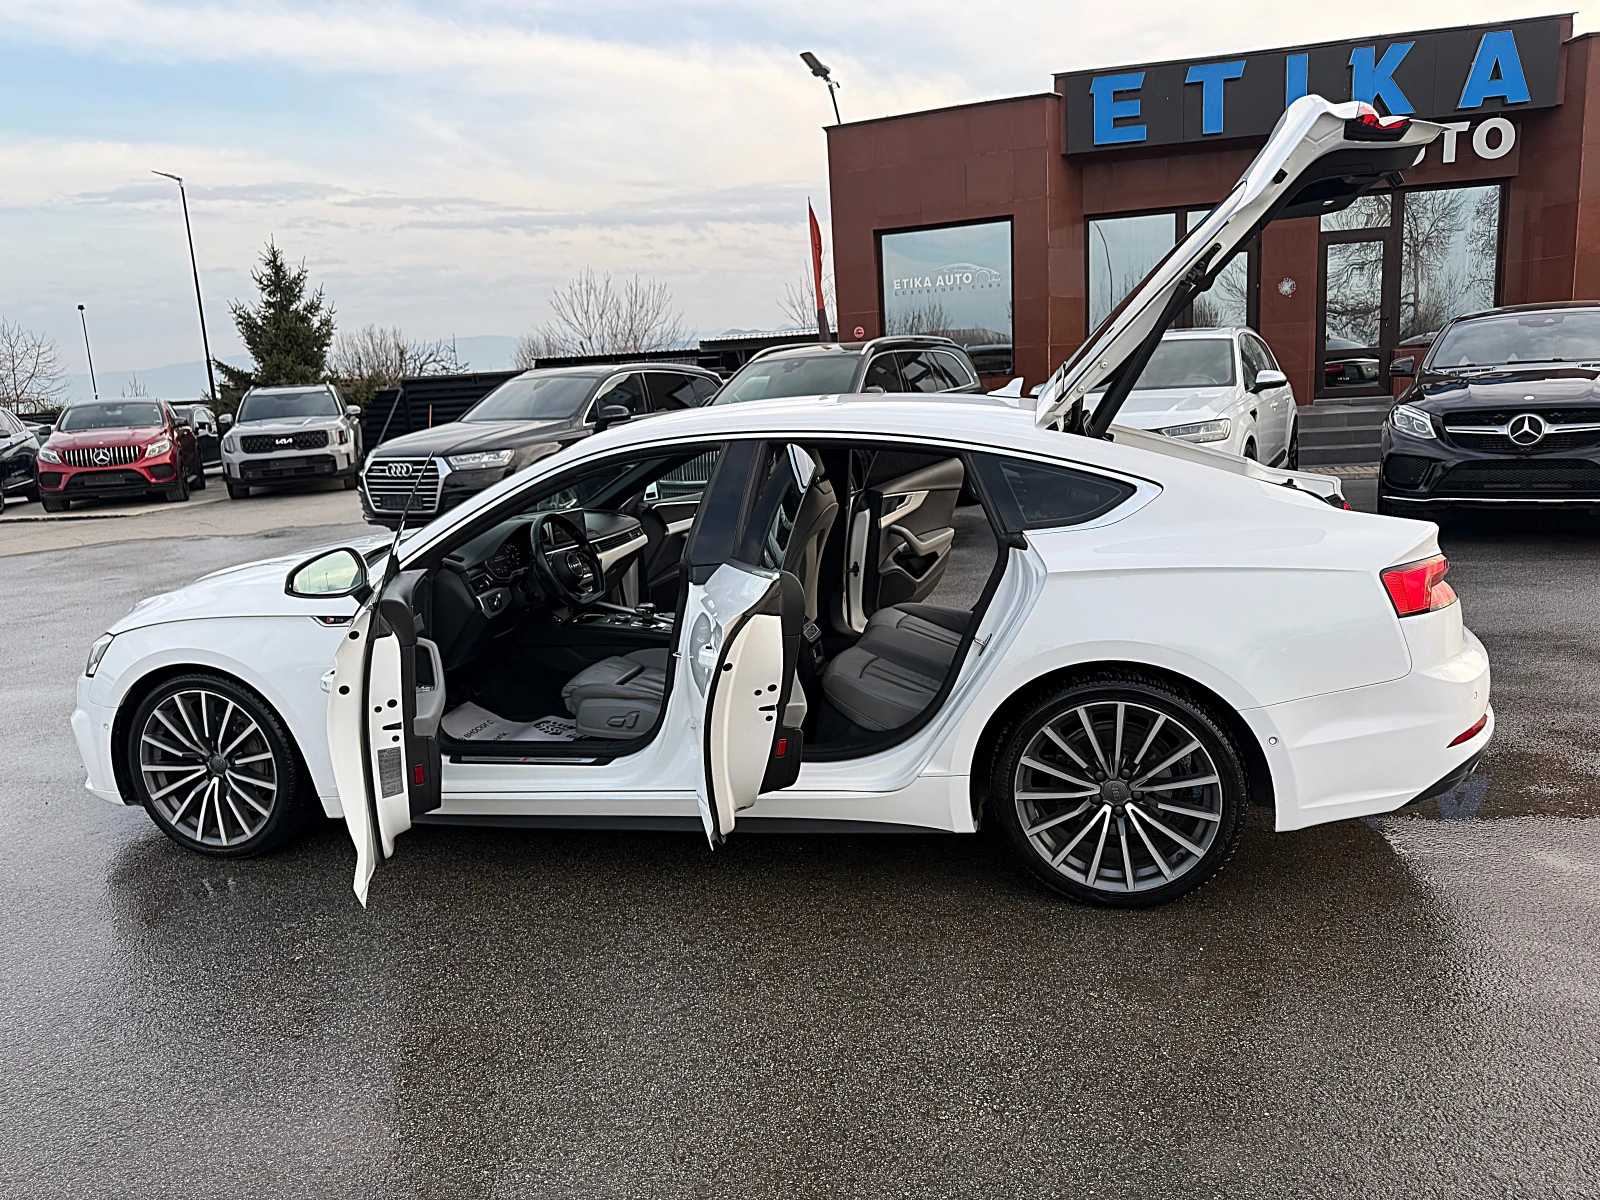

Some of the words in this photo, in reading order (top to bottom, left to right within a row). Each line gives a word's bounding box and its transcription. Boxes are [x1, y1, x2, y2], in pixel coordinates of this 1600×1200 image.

[1089, 29, 1532, 146] ETIKA
[1411, 117, 1516, 167] TO
[893, 276, 932, 290] ETIKA
[935, 272, 973, 287] AUTO
[894, 286, 962, 297] LUXURIOUS
